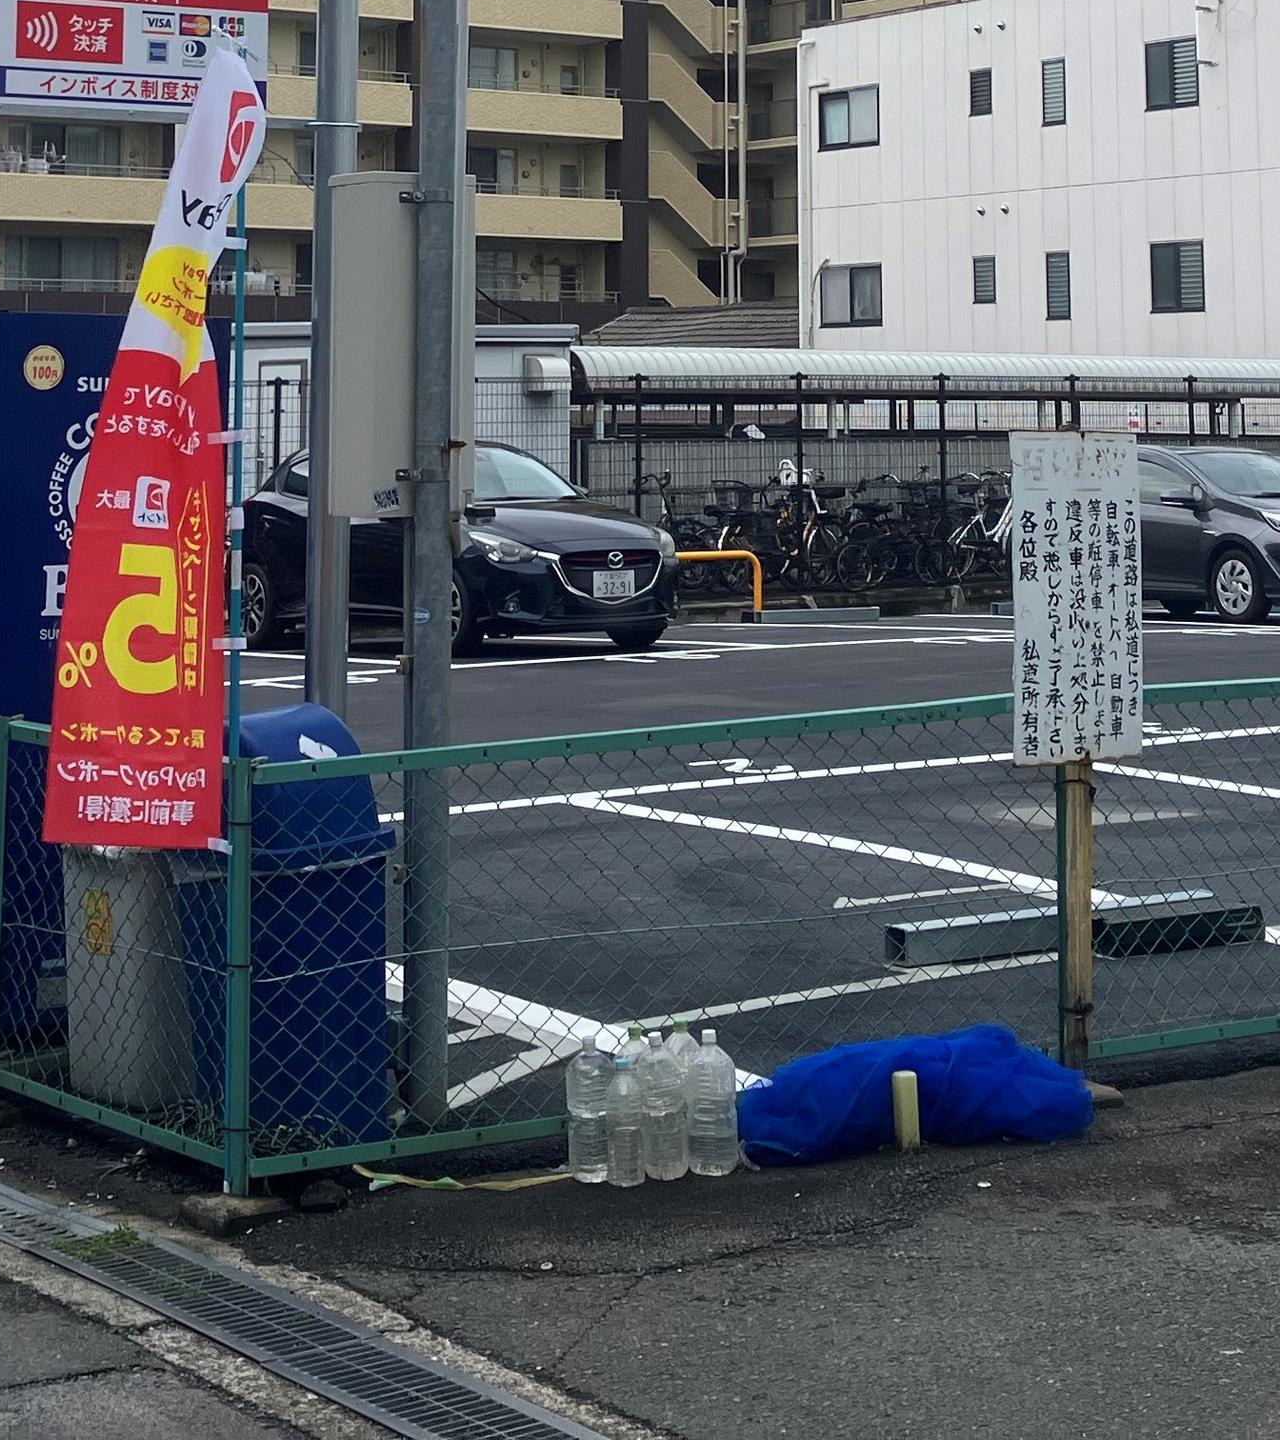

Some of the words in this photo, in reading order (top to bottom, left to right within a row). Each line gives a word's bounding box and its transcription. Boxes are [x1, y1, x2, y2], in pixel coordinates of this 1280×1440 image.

[69, 14, 114, 33] タッチ
[146, 17, 172, 29] VISA
[73, 34, 108, 53] 決済
[49, 452, 74, 517] COFFEE
